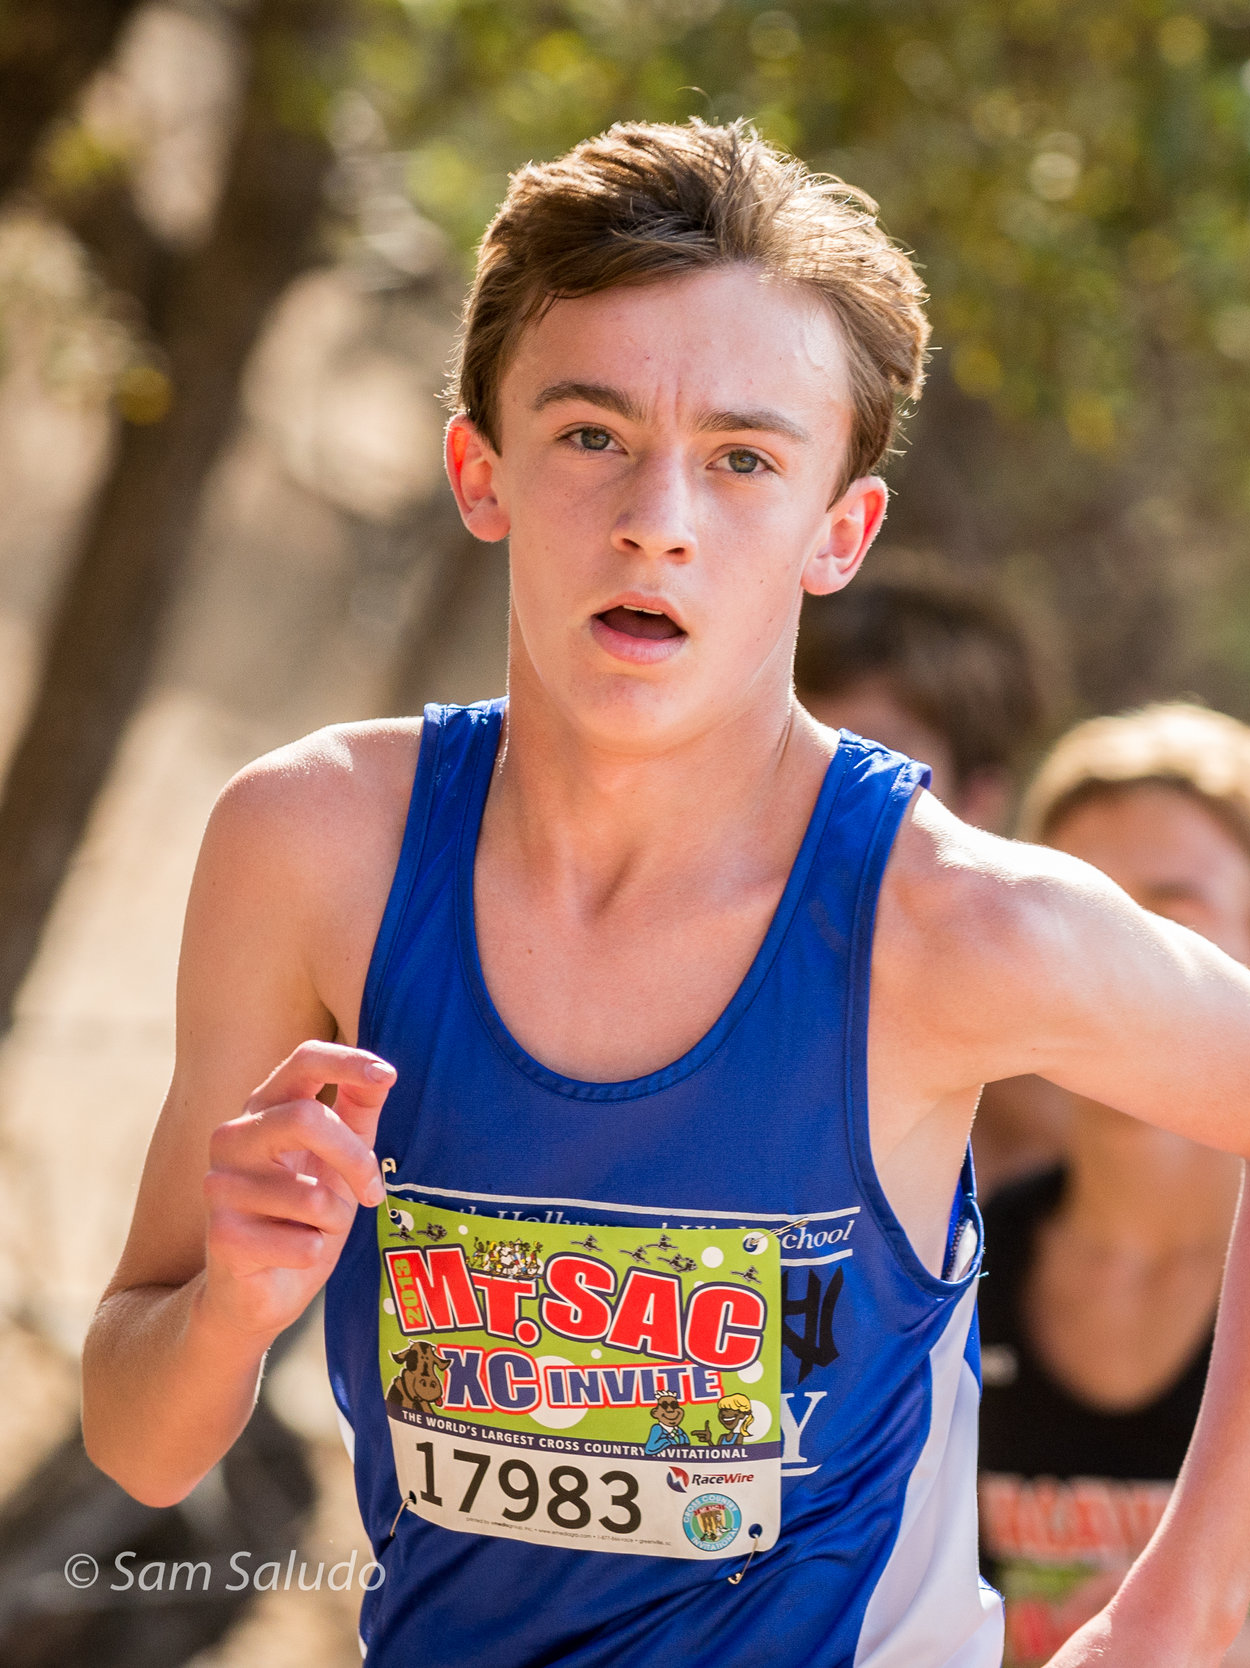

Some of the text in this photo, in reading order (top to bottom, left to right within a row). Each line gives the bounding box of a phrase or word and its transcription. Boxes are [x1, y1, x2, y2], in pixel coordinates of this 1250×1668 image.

[393, 1256, 424, 1325] 2013
[541, 1253, 766, 1371] SAC
[439, 1345, 723, 1412] XC INVITE
[402, 1410, 422, 1424] THE
[426, 1416, 477, 1437] WORLD'S
[482, 1428, 534, 1446] LARGEST
[539, 1438, 579, 1452] CROSS
[652, 1448, 748, 1460] NVITATIONAL
[416, 1441, 641, 1534] 17983
[691, 1472, 754, 1486] RaceWire
